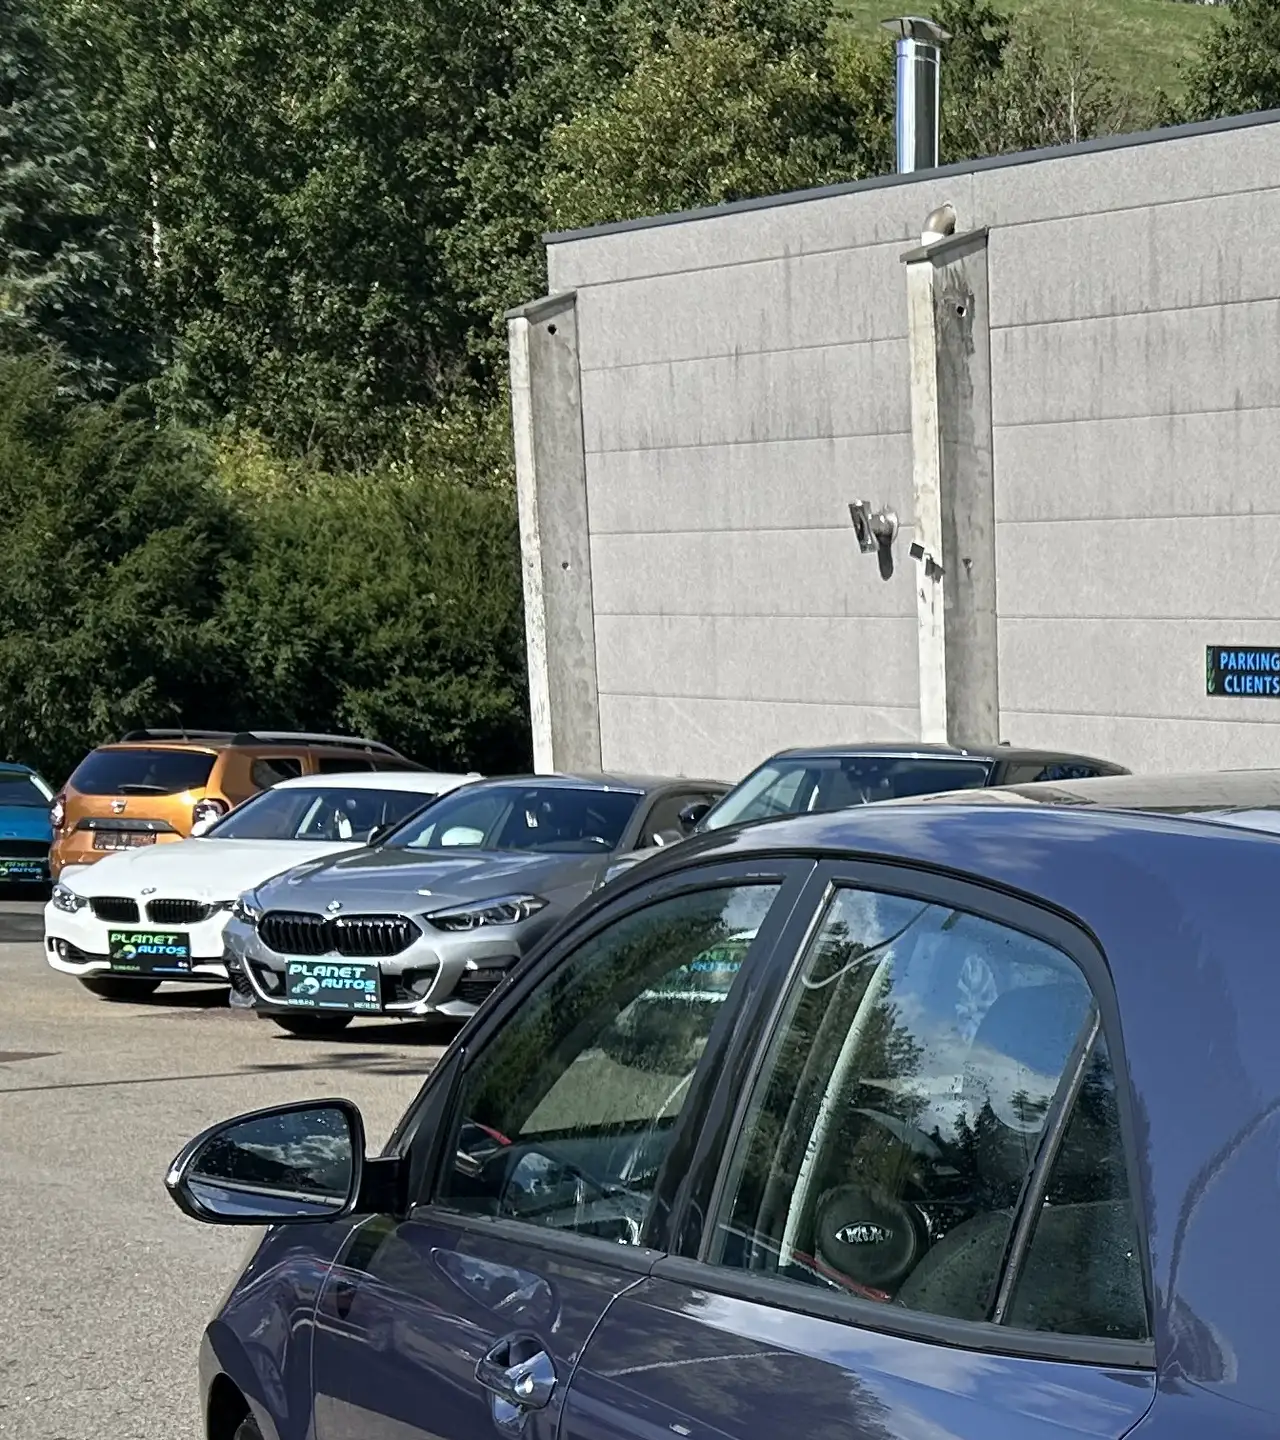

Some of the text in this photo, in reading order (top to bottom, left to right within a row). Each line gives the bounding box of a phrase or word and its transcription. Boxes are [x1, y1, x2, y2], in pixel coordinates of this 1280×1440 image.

[1220, 652, 1280, 671] PARKING
[1224, 674, 1280, 694] CLIENTS
[111, 933, 178, 945] PLANET
[138, 945, 187, 955] AUTOS
[289, 964, 366, 979] PLANET
[321, 978, 376, 990] AUTOS
